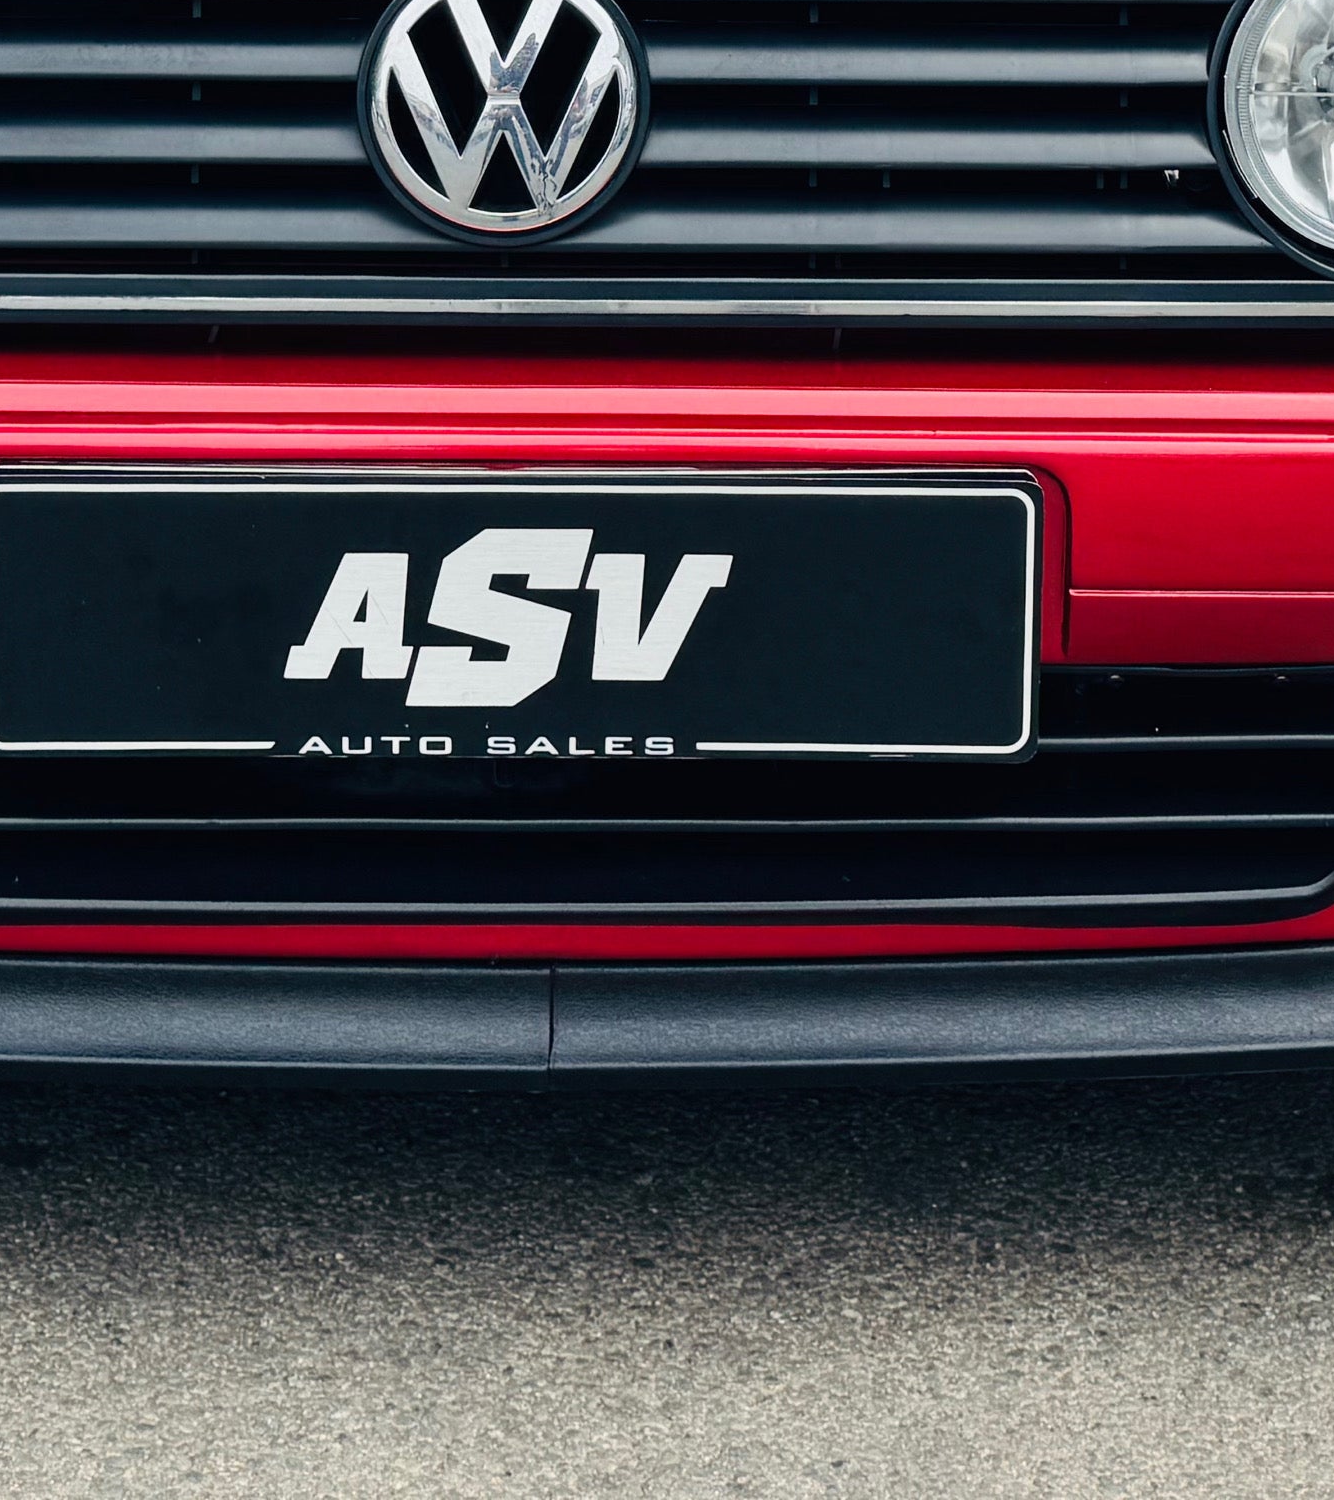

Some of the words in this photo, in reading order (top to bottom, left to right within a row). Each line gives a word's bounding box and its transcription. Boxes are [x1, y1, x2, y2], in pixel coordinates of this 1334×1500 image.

[283, 528, 734, 707] ASV
[298, 735, 453, 756] AUTO
[486, 735, 674, 757] SALES
